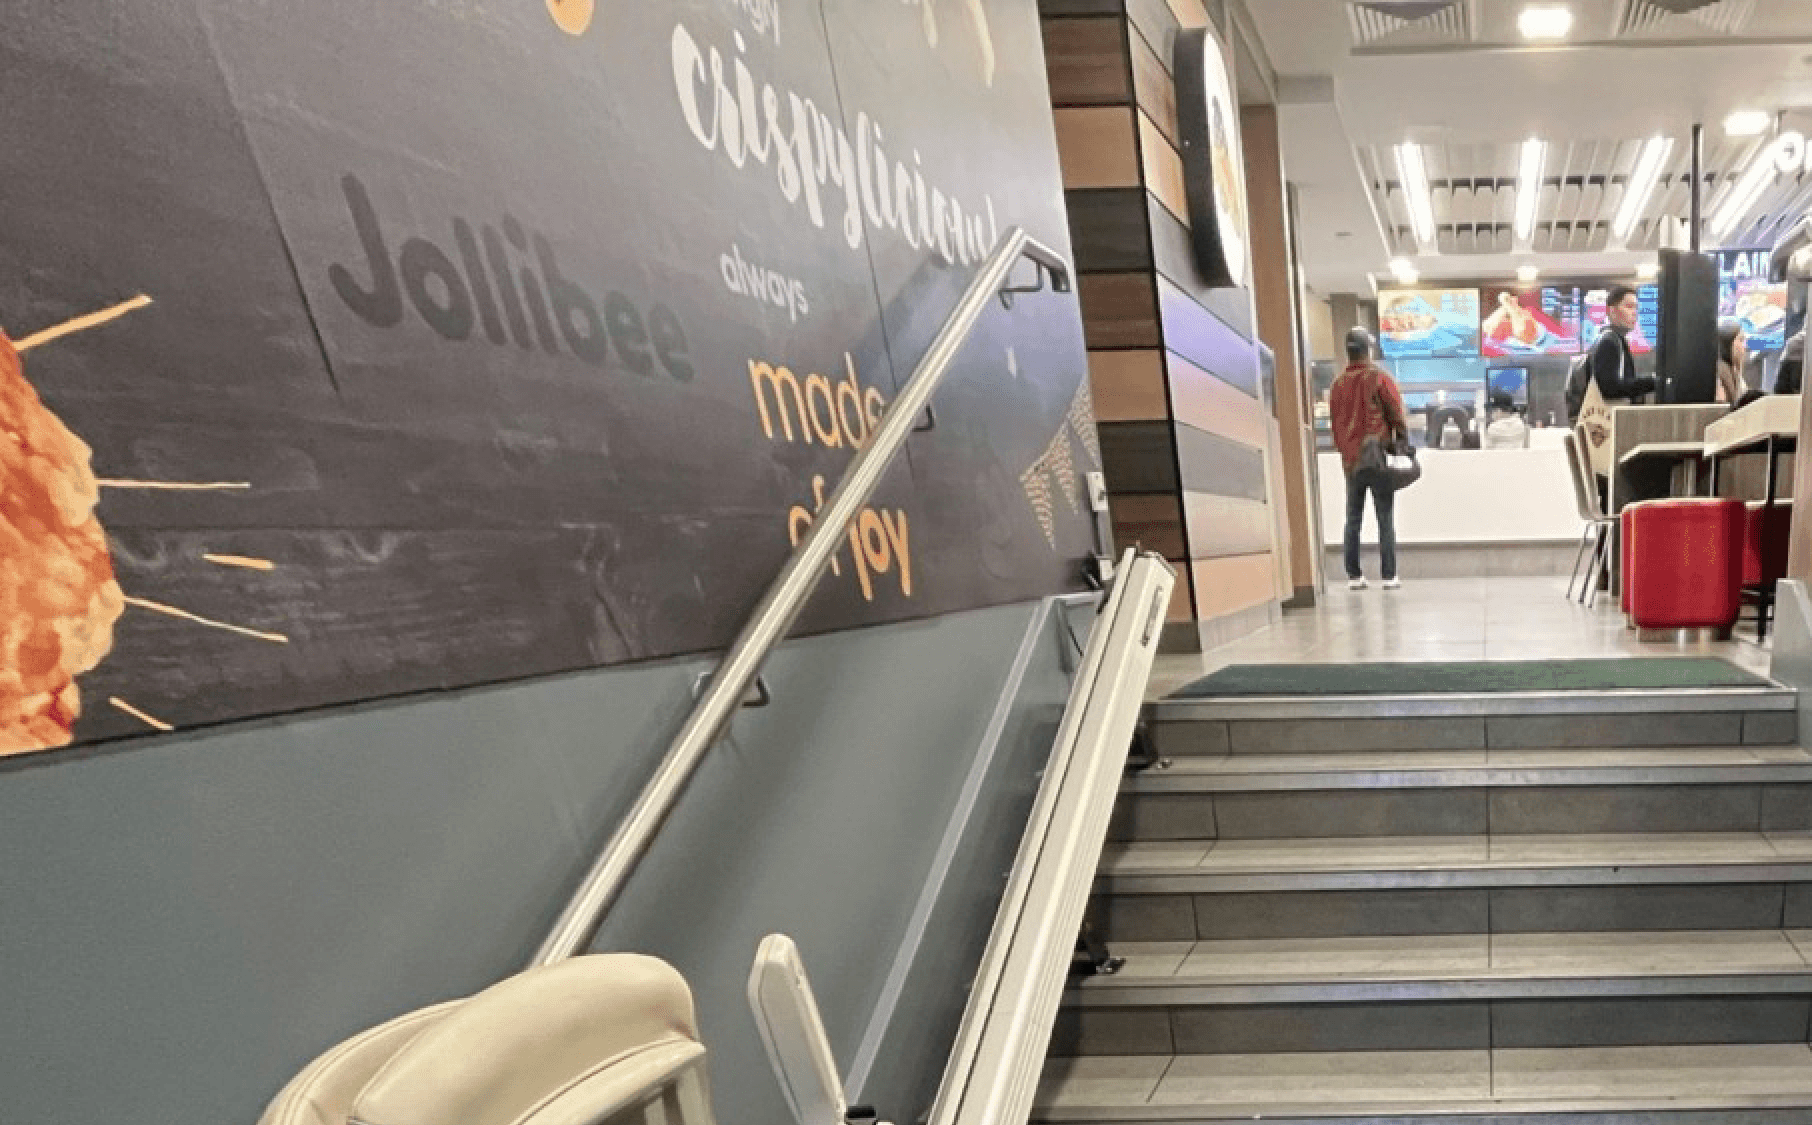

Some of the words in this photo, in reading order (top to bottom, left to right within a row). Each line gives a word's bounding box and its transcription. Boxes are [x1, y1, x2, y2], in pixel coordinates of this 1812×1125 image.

[328, 173, 693, 383] Jollibee
[719, 243, 809, 323] always
[850, 507, 912, 602] joy
